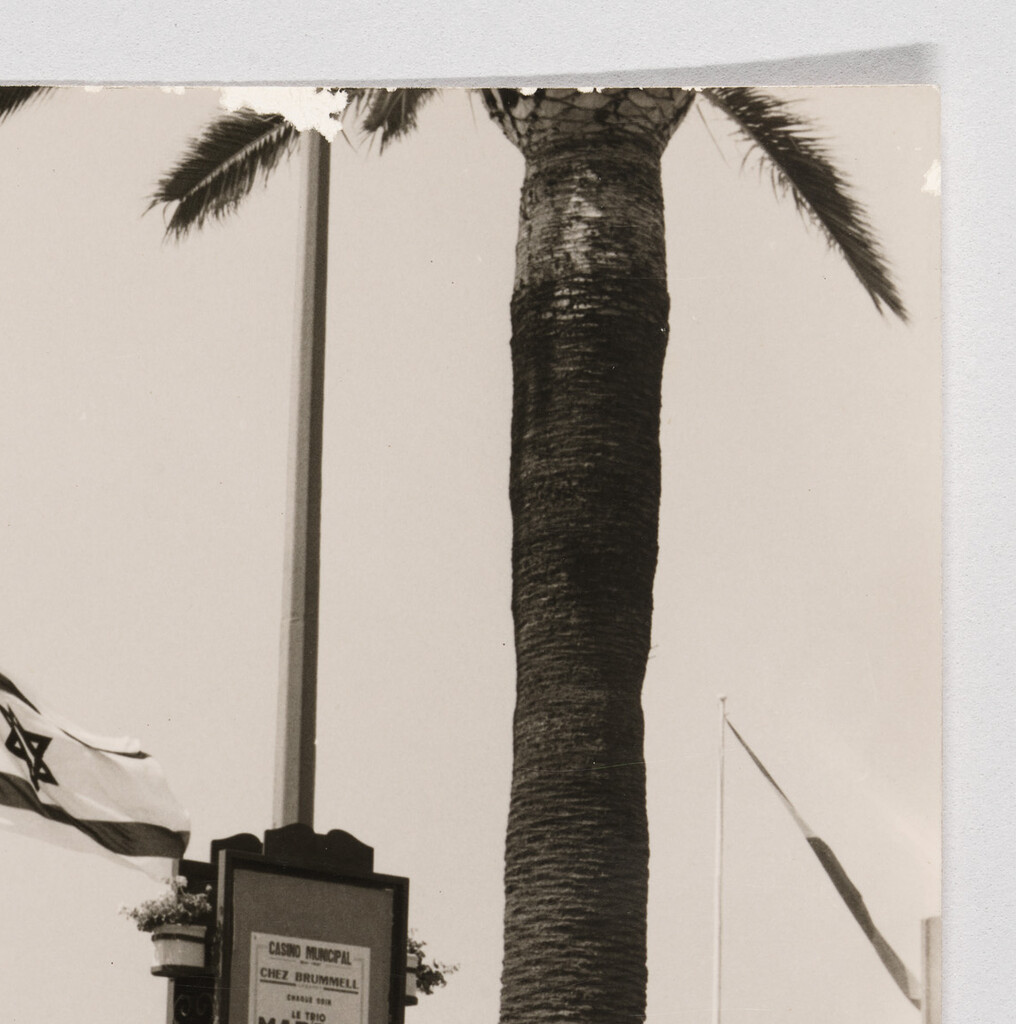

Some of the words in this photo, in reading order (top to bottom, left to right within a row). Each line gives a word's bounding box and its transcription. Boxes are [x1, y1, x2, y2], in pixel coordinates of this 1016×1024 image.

[268, 941, 301, 958] CASINO
[305, 945, 352, 965] MUNICIPAL
[259, 967, 289, 981] CHEZ
[295, 971, 359, 989] BRUMMELL
[291, 1010, 301, 1019] LE
[305, 1011, 326, 1022] TRIO
